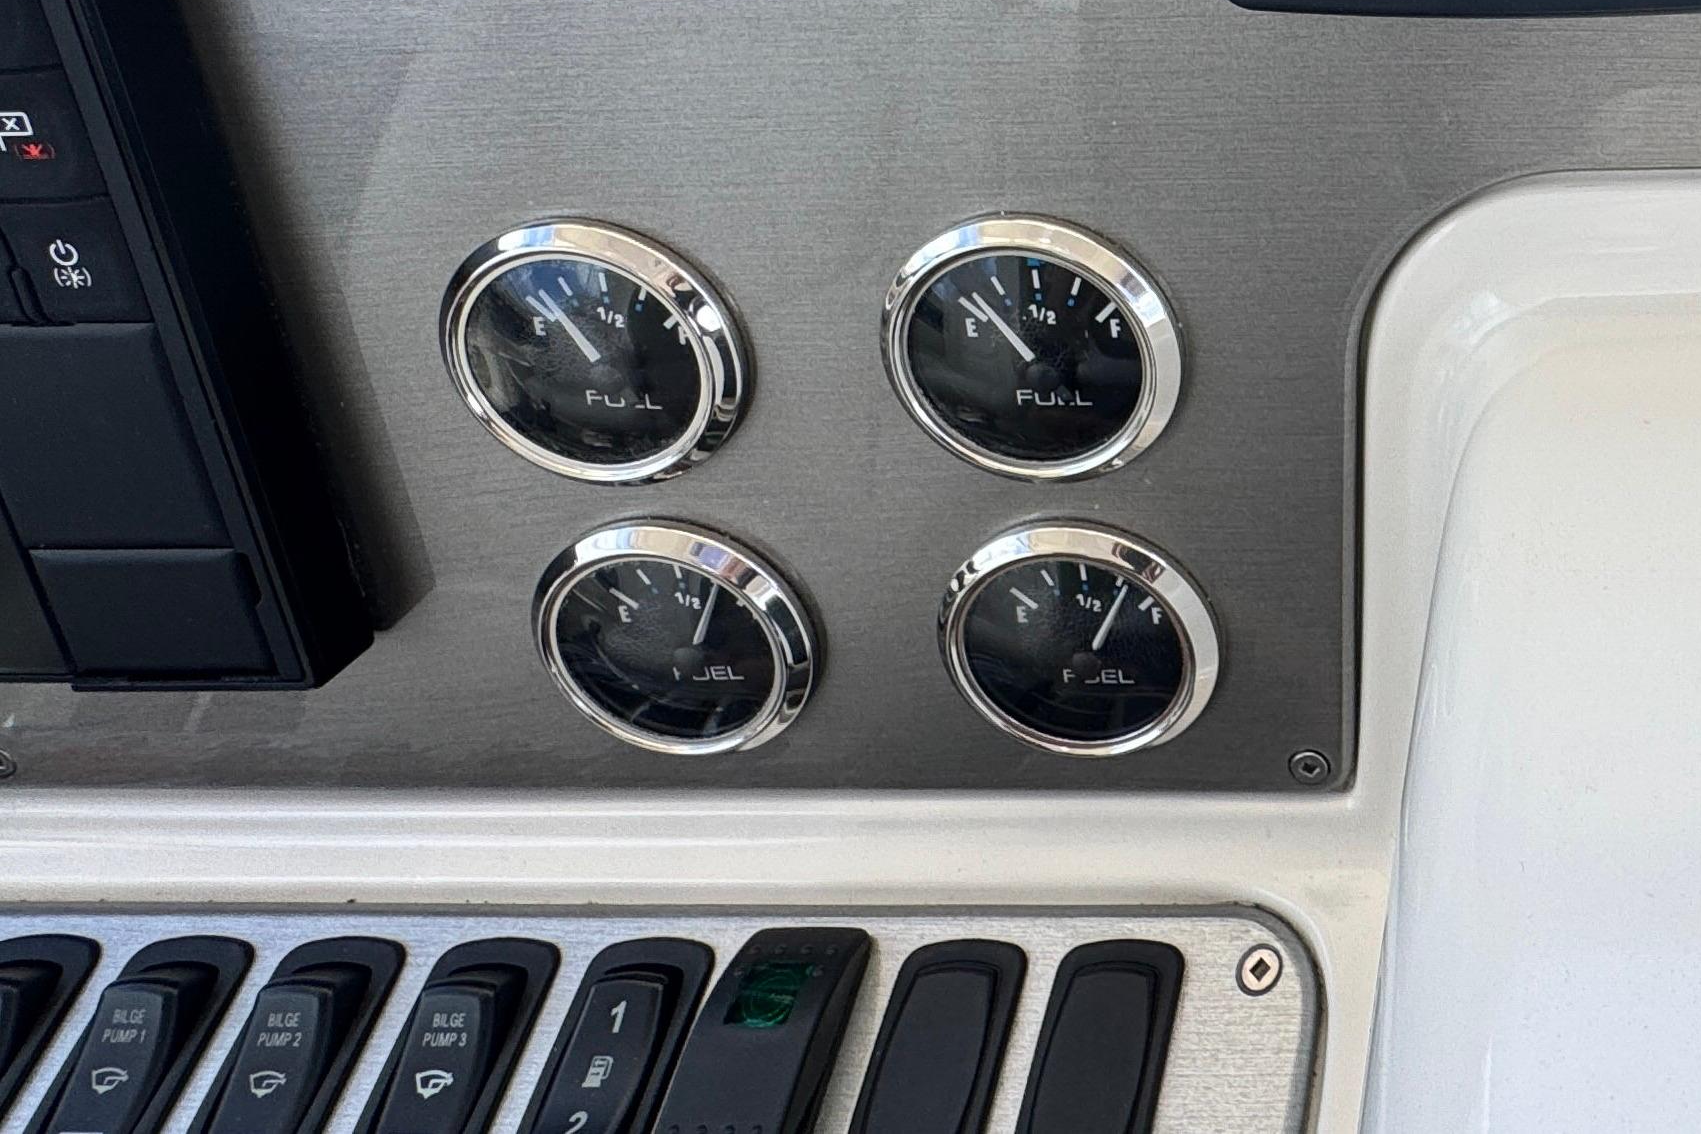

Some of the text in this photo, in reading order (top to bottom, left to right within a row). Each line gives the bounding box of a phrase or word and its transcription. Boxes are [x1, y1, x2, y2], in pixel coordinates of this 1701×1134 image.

[597, 306, 625, 328] 1/2
[1028, 304, 1057, 326] 1/2
[533, 317, 546, 336] E
[965, 318, 978, 337] E
[1110, 319, 1121, 338] F
[585, 389, 663, 410] FUL
[675, 591, 701, 610] 1/2
[1075, 593, 1101, 612] 1/2
[618, 605, 632, 623] E
[1016, 606, 1029, 624] E
[1151, 607, 1162, 625] F
[112, 1008, 147, 1024] BILGE
[267, 1012, 301, 1028] BILGE
[432, 1012, 466, 1028] BILGE
[611, 1000, 627, 1034] 1
[101, 1028, 146, 1043] PUMP 1
[257, 1032, 302, 1047] PUMP 2
[422, 1032, 468, 1047] PUMP 3
[564, 1111, 588, 1134] 2
